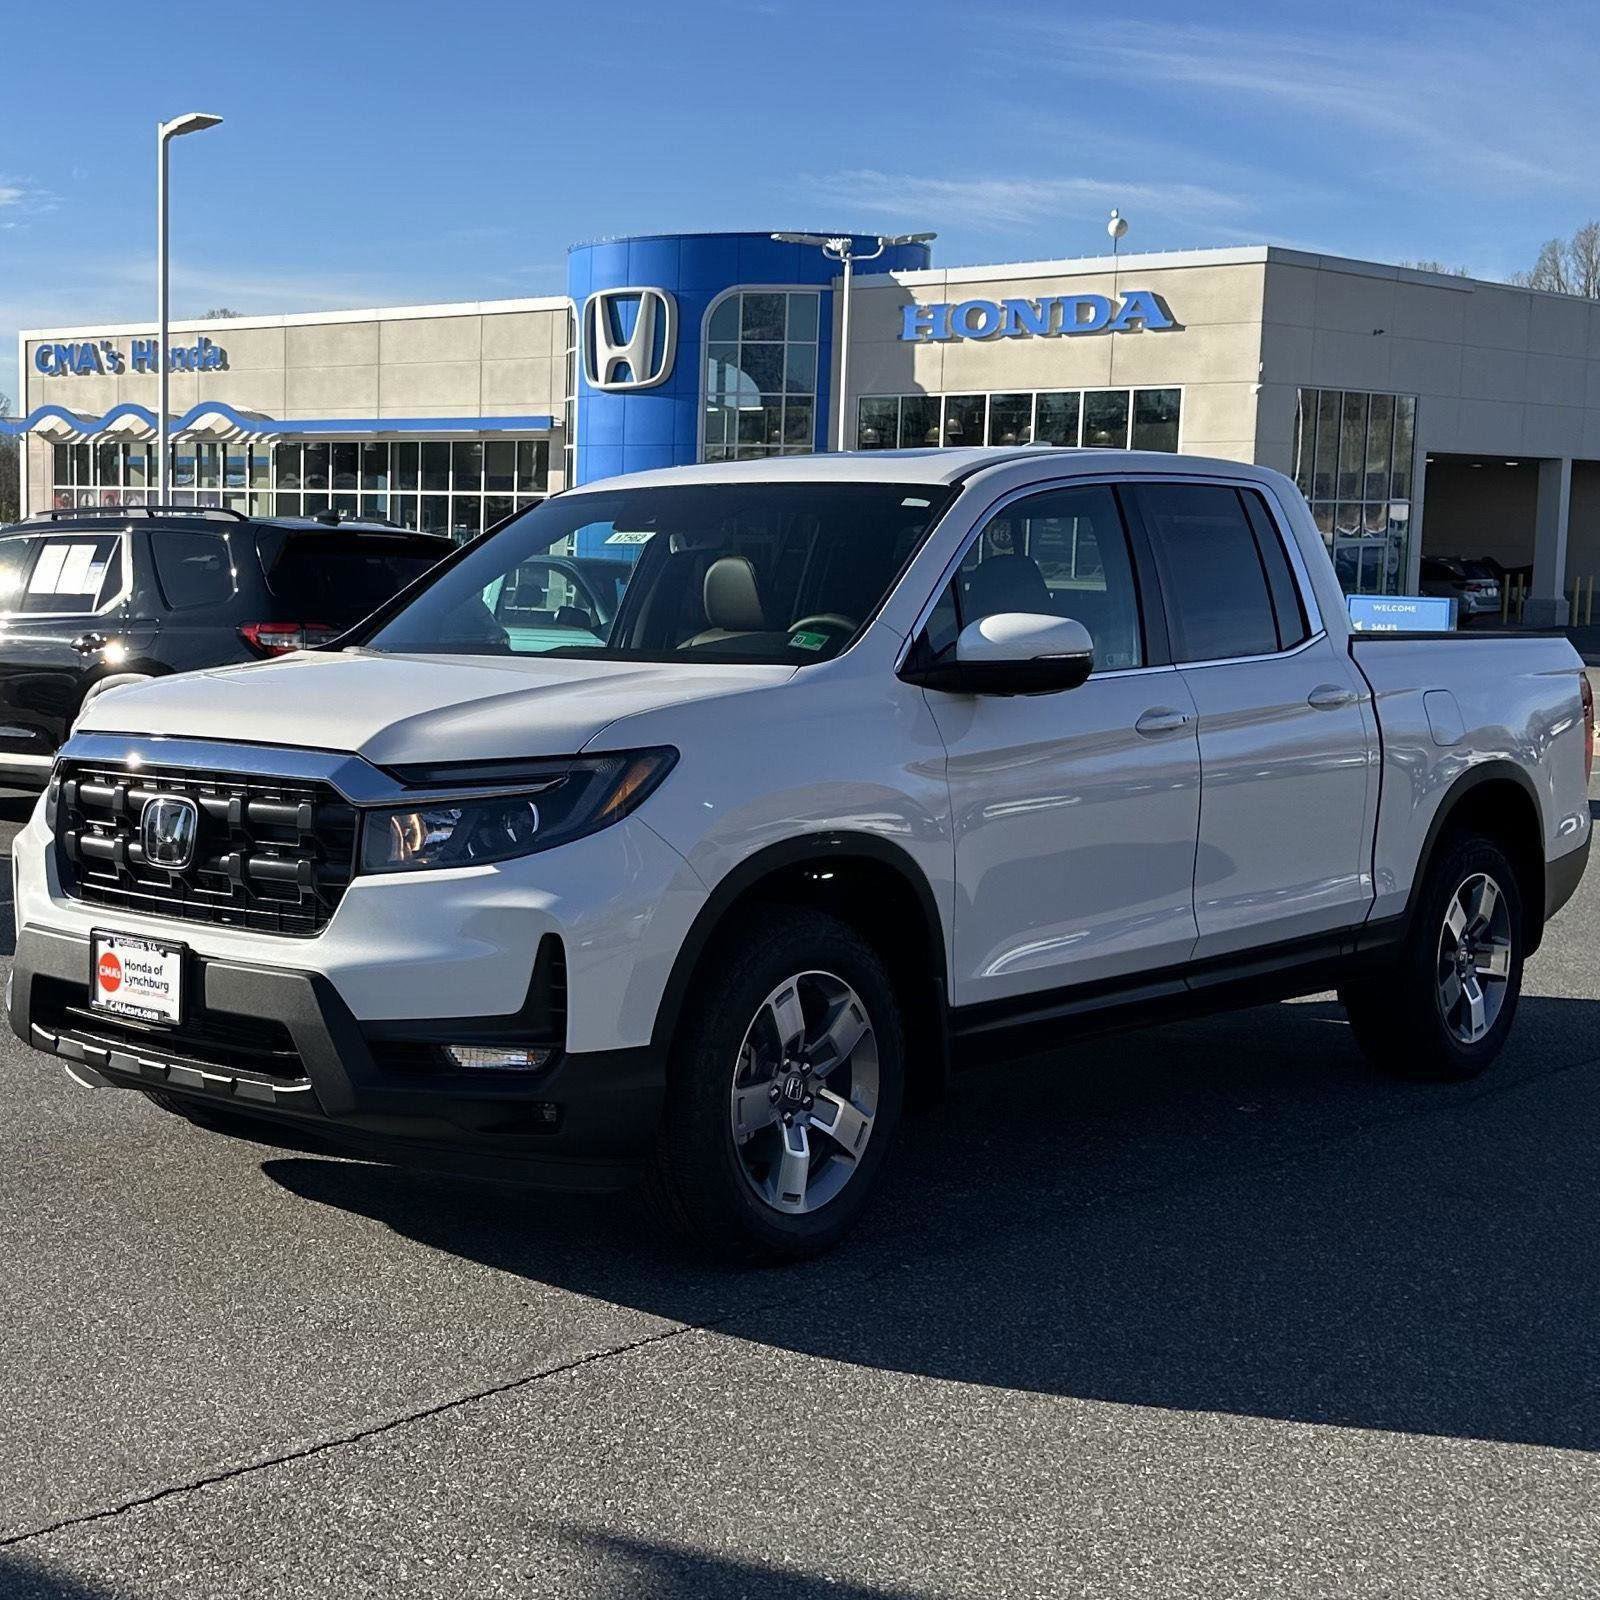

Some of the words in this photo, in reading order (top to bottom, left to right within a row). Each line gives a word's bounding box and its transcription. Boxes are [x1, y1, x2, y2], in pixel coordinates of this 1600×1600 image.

[901, 291, 1174, 342] HONDA
[34, 341, 121, 375] CMA's
[131, 336, 222, 371] Hnda
[1372, 604, 1417, 613] WELCOME
[1371, 623, 1398, 631] SALES
[124, 958, 152, 974] Honda
[154, 965, 163, 976] of
[124, 973, 169, 993] Lynchburg
